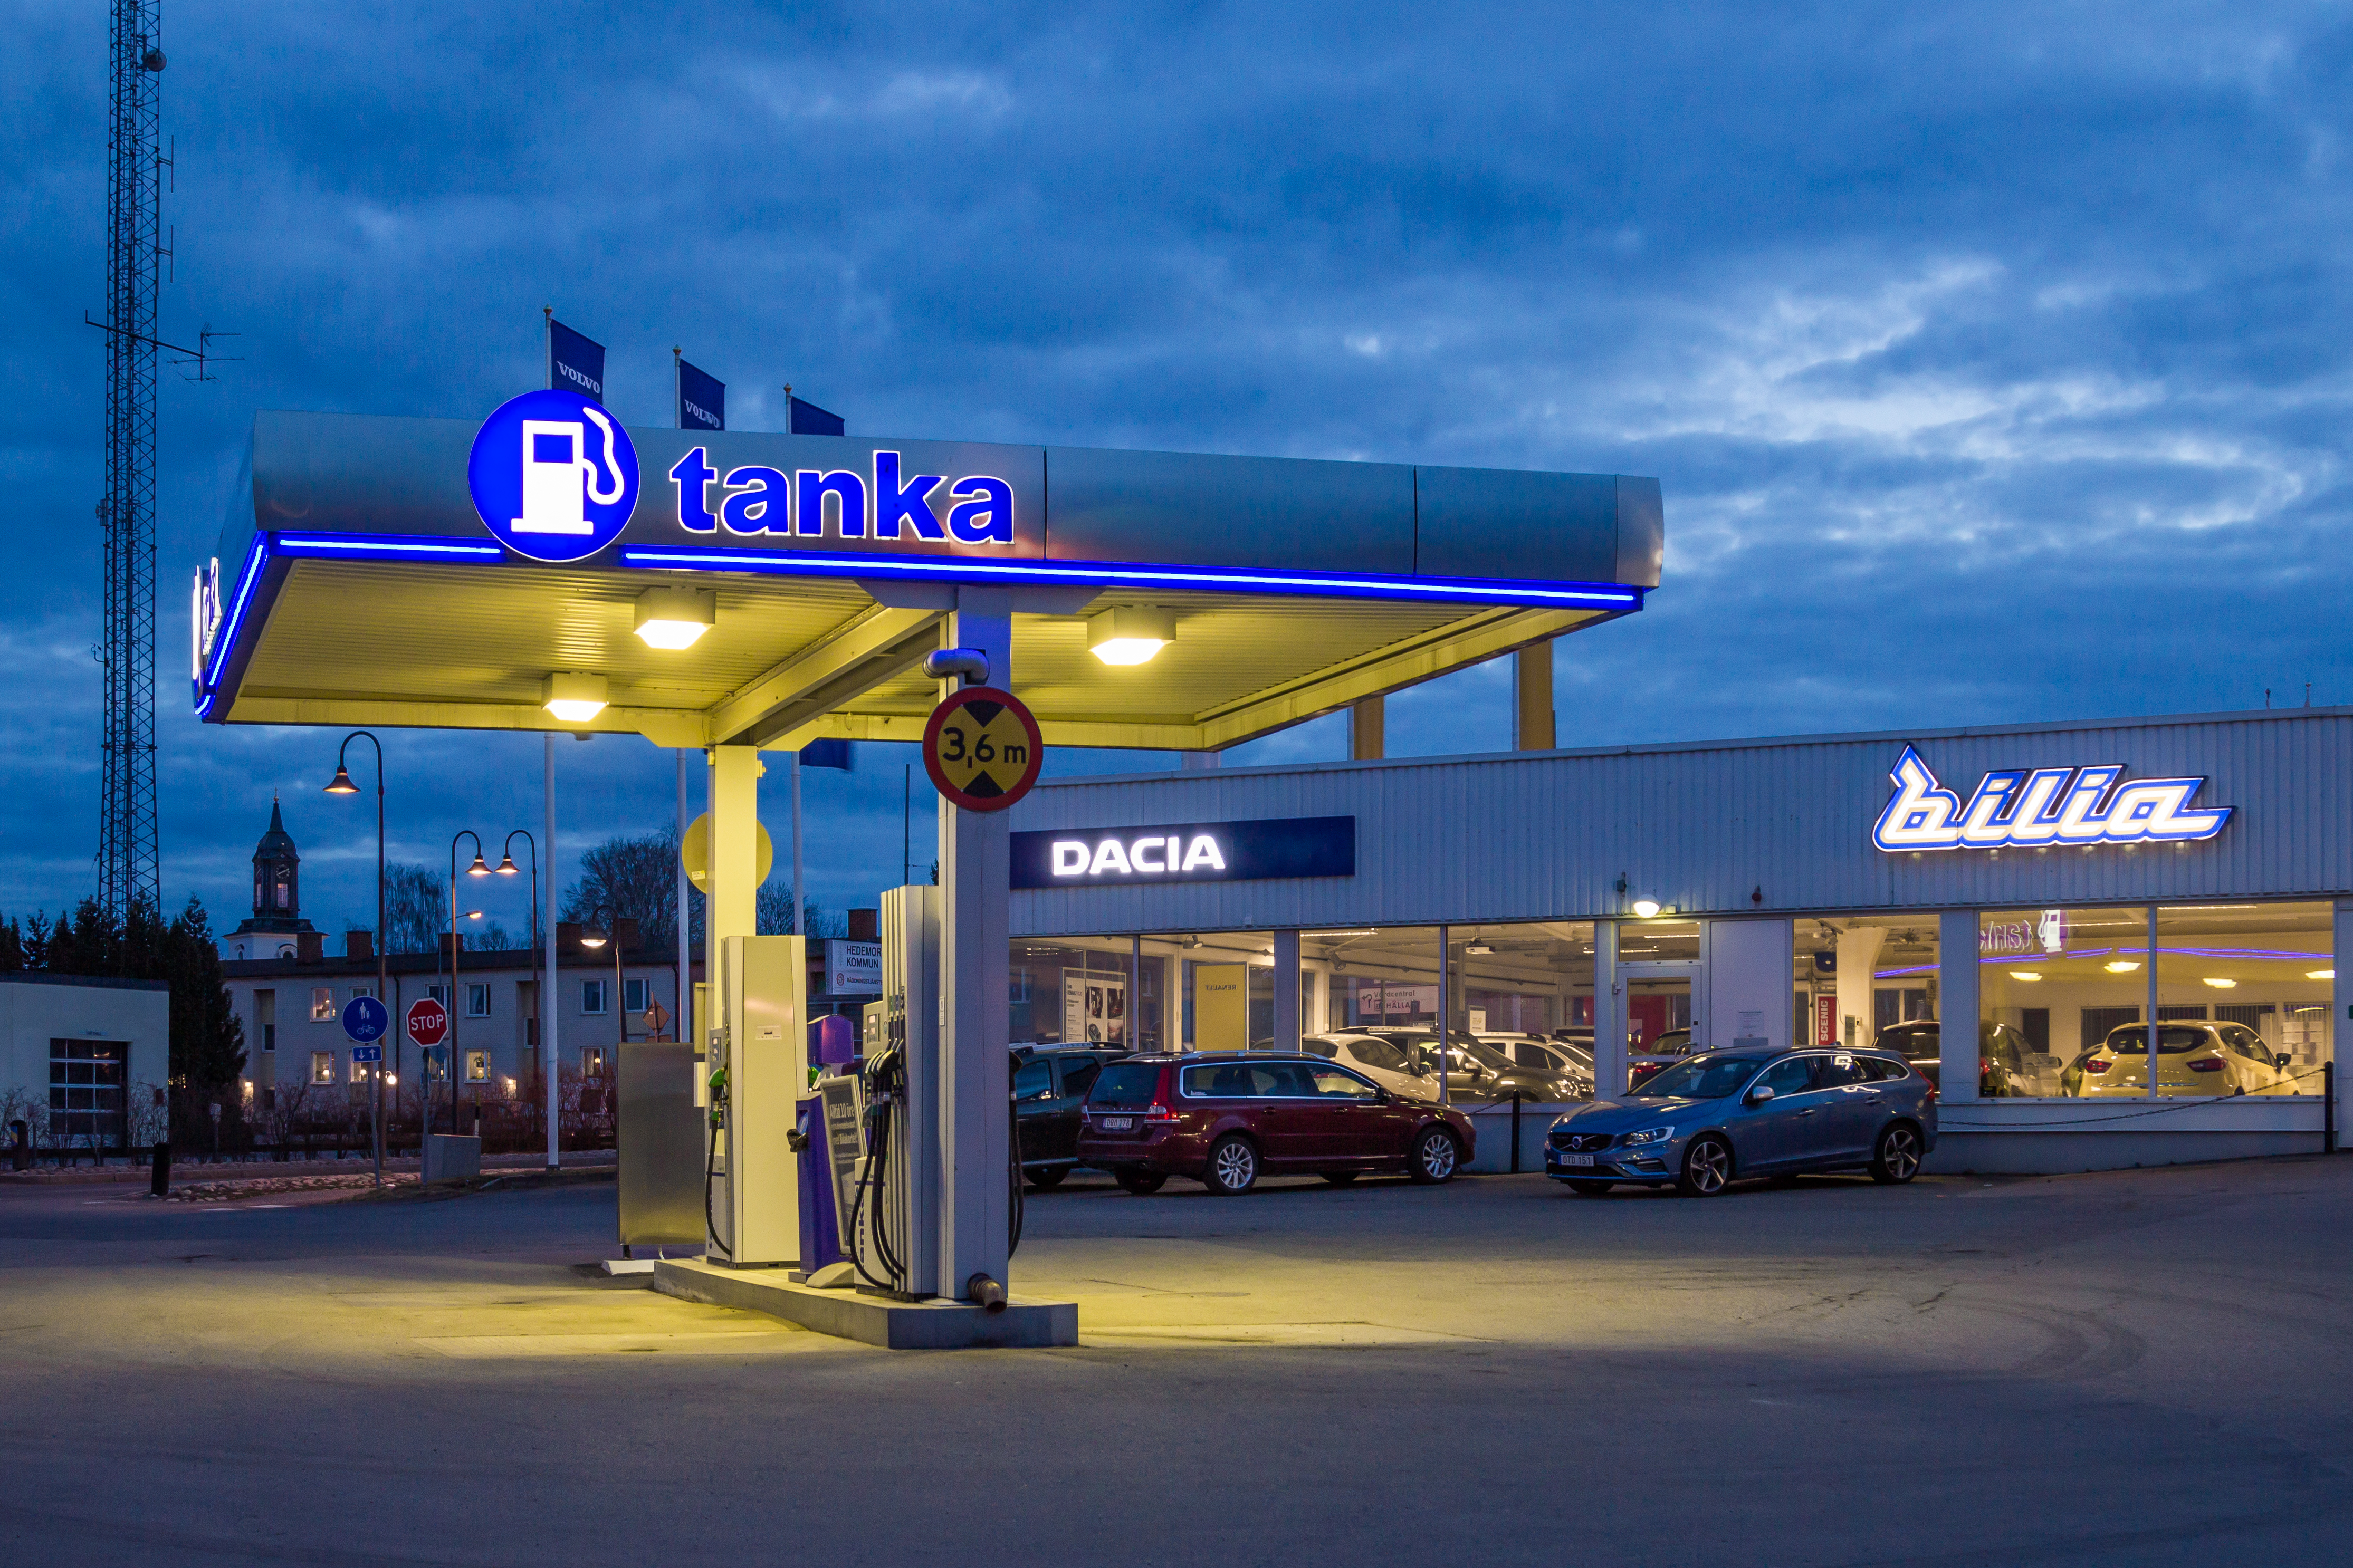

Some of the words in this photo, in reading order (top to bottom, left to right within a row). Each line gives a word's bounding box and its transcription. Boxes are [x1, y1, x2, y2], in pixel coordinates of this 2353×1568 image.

[557, 361, 600, 394] VOLVO
[685, 399, 721, 428] VOLVO
[669, 447, 1015, 545] tanka
[943, 727, 996, 768] 3,6
[1004, 744, 1026, 764] m
[1871, 742, 2237, 852] bilia
[1053, 835, 1226, 876] DACIA
[846, 945, 882, 957] HEDEMOR
[846, 957, 878, 968] KOMMUN
[410, 1014, 444, 1031] STOP
[1820, 1000, 1829, 1041] SCENIC
[1118, 1119, 1130, 1127] 278
[1579, 1156, 1591, 1165] 151
